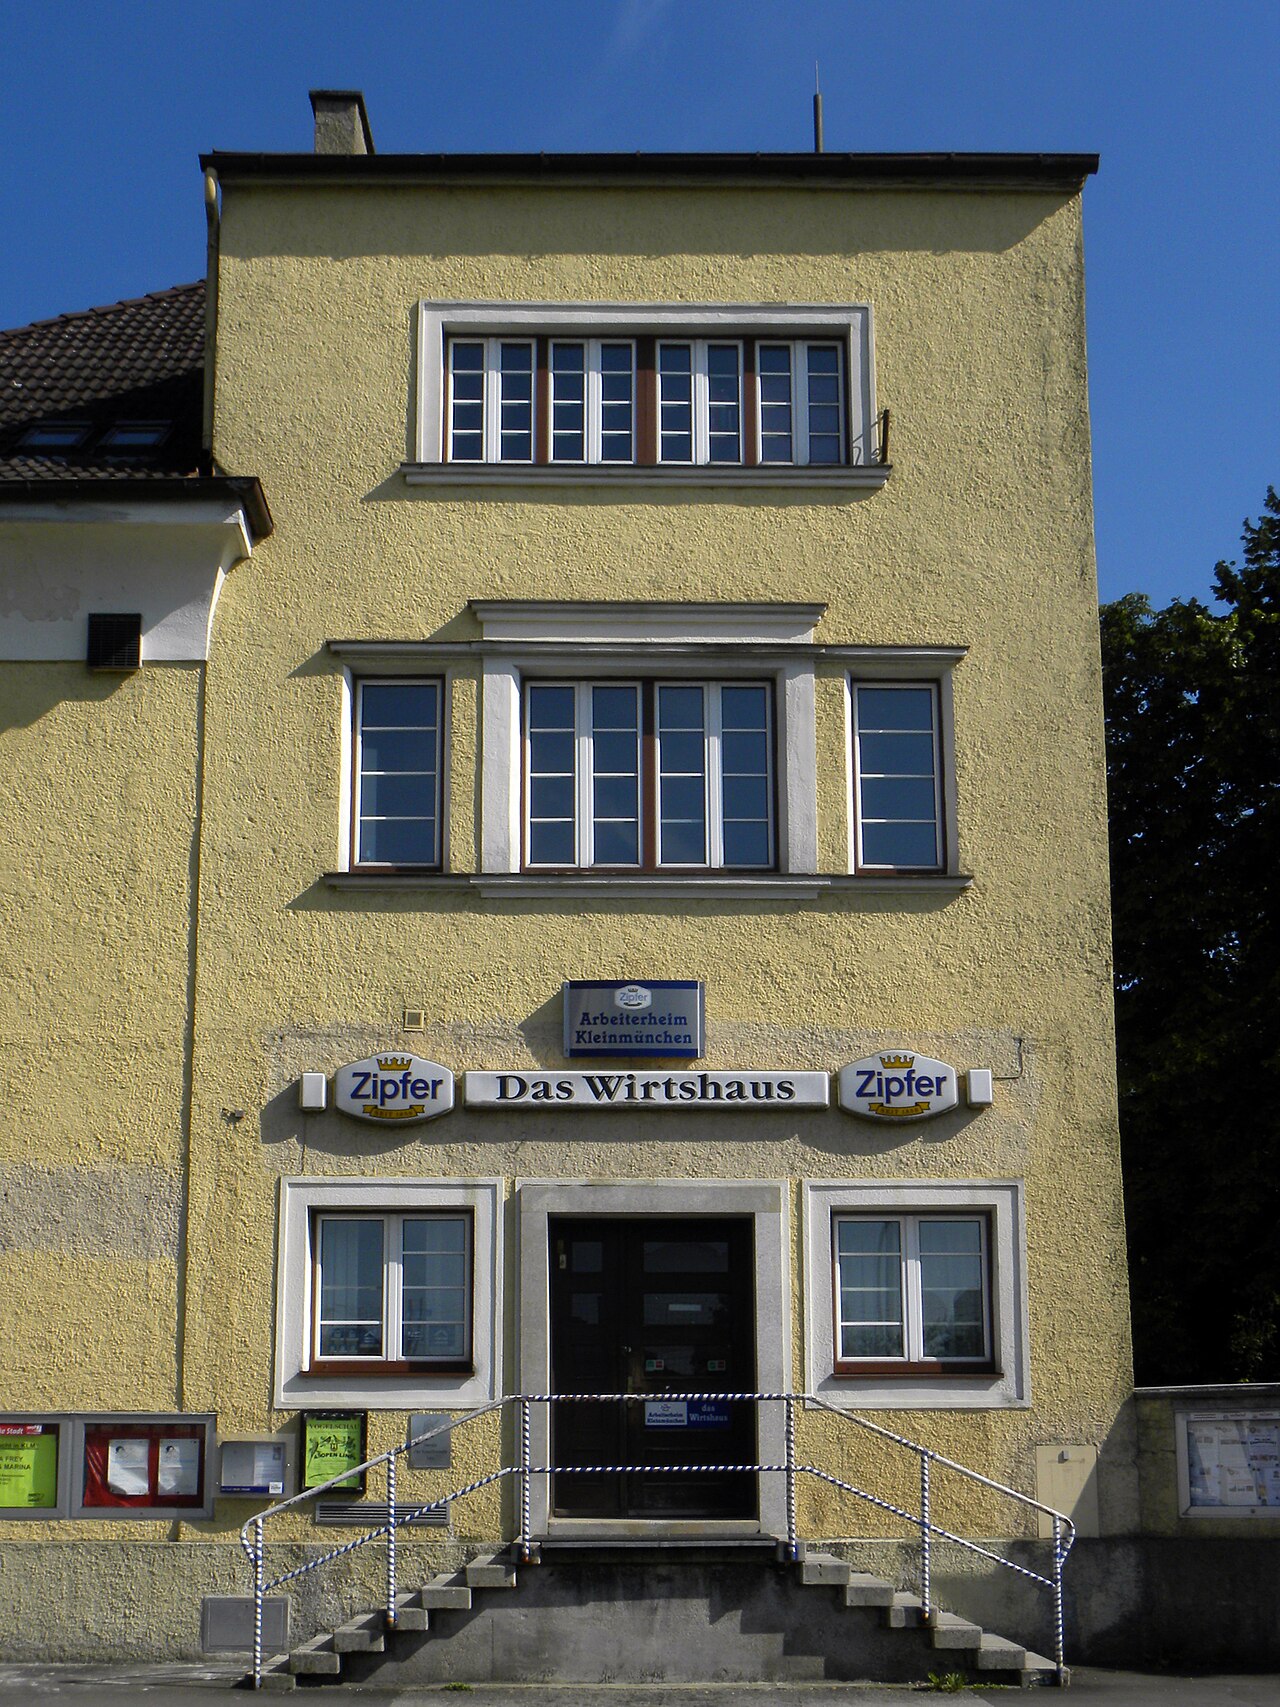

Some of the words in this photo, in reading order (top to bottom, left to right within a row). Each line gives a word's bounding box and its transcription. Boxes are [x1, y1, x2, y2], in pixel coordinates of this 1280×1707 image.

[620, 992, 648, 1003] Zipfer
[579, 1013, 688, 1026] Arbeiterheim
[575, 1030, 692, 1044] Kleinmünchen
[350, 1071, 443, 1106] Zipfer
[495, 1074, 574, 1102] Das
[582, 1073, 796, 1102] Wirtshaus
[855, 1069, 947, 1104] Zipfer
[701, 1404, 716, 1412] das
[689, 1413, 728, 1422] Wirtshaus
[7, 1426, 24, 1435] Stadt
